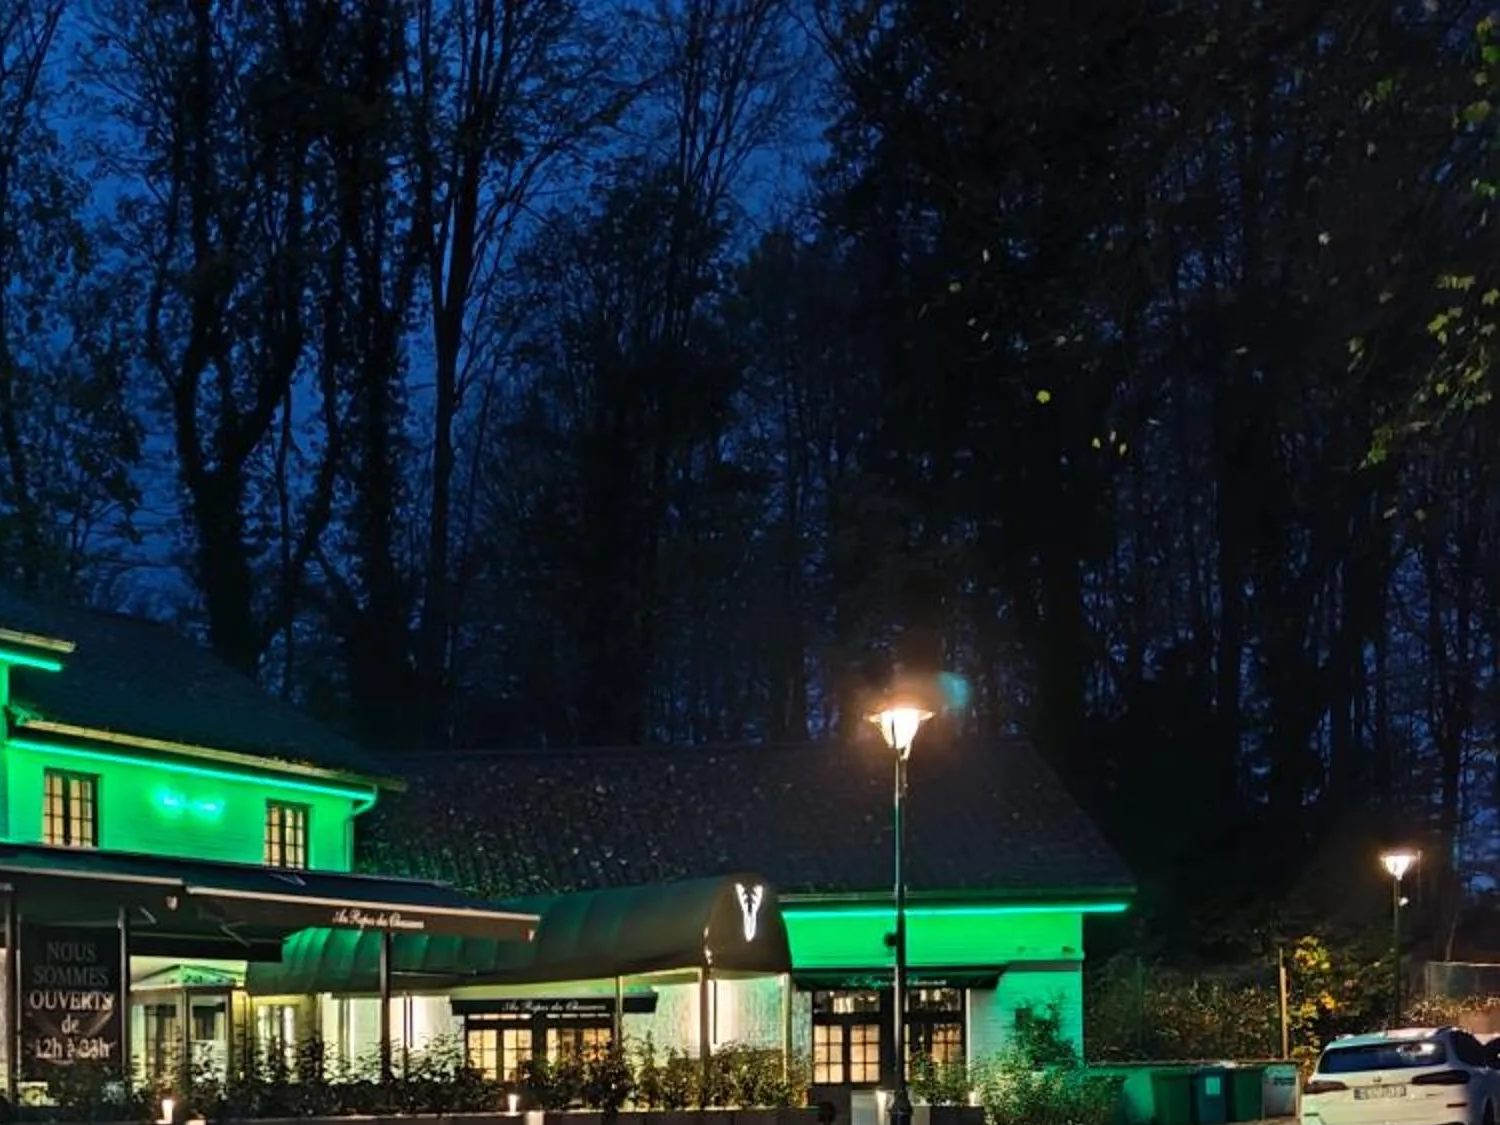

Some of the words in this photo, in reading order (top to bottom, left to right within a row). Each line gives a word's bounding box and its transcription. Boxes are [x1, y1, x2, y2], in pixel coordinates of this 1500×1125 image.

[46, 941, 98, 963] NOUS
[33, 965, 109, 987] SOMMES
[29, 990, 115, 1011] OUVERTS
[61, 1013, 80, 1034] de
[35, 1036, 63, 1059] 12h
